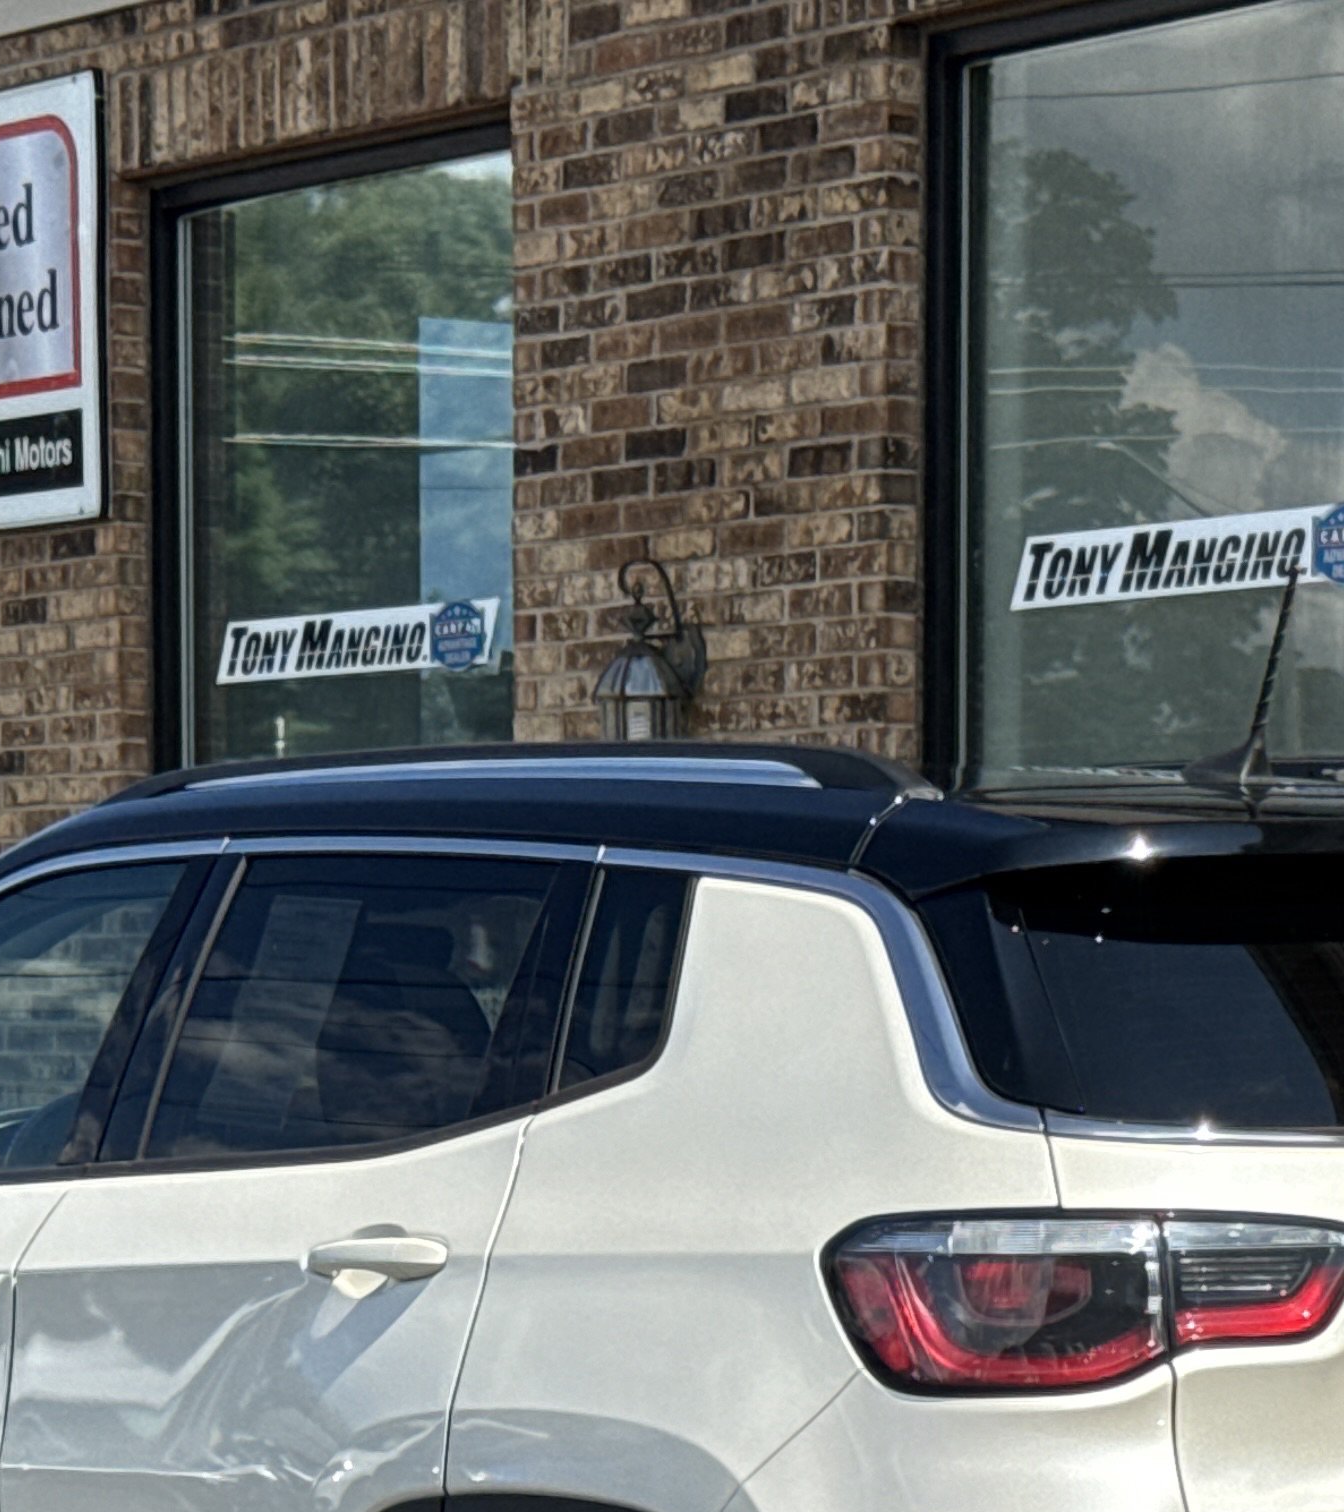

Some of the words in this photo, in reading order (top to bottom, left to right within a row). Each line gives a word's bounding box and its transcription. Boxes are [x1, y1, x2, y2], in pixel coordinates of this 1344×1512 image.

[14, 435, 73, 473] Motors
[1022, 541, 1125, 602] TONY
[226, 625, 298, 677] TONY
